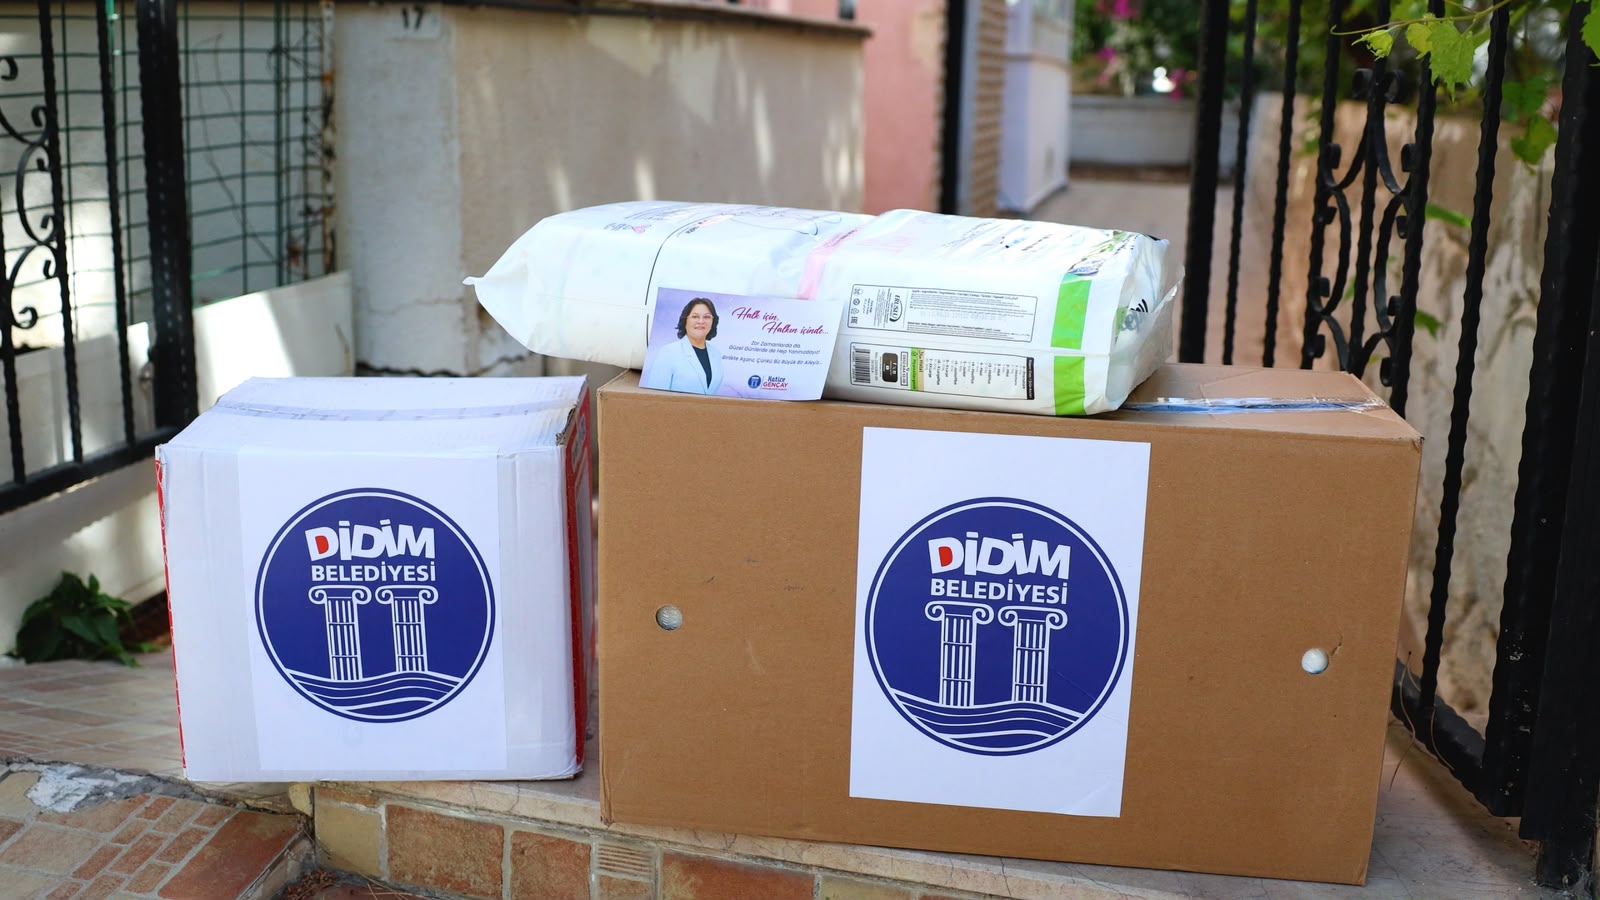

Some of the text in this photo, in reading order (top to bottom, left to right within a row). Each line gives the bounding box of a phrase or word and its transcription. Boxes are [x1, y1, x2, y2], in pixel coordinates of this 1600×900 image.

[402, 5, 424, 30] 17
[731, 306, 761, 320] Halk
[762, 321, 797, 334] Halkın
[305, 519, 435, 561] DİDİM
[928, 531, 1071, 580] DİDİM
[311, 561, 436, 581] BELEDİYESİ
[930, 578, 1068, 605] BELEDİYESİ
